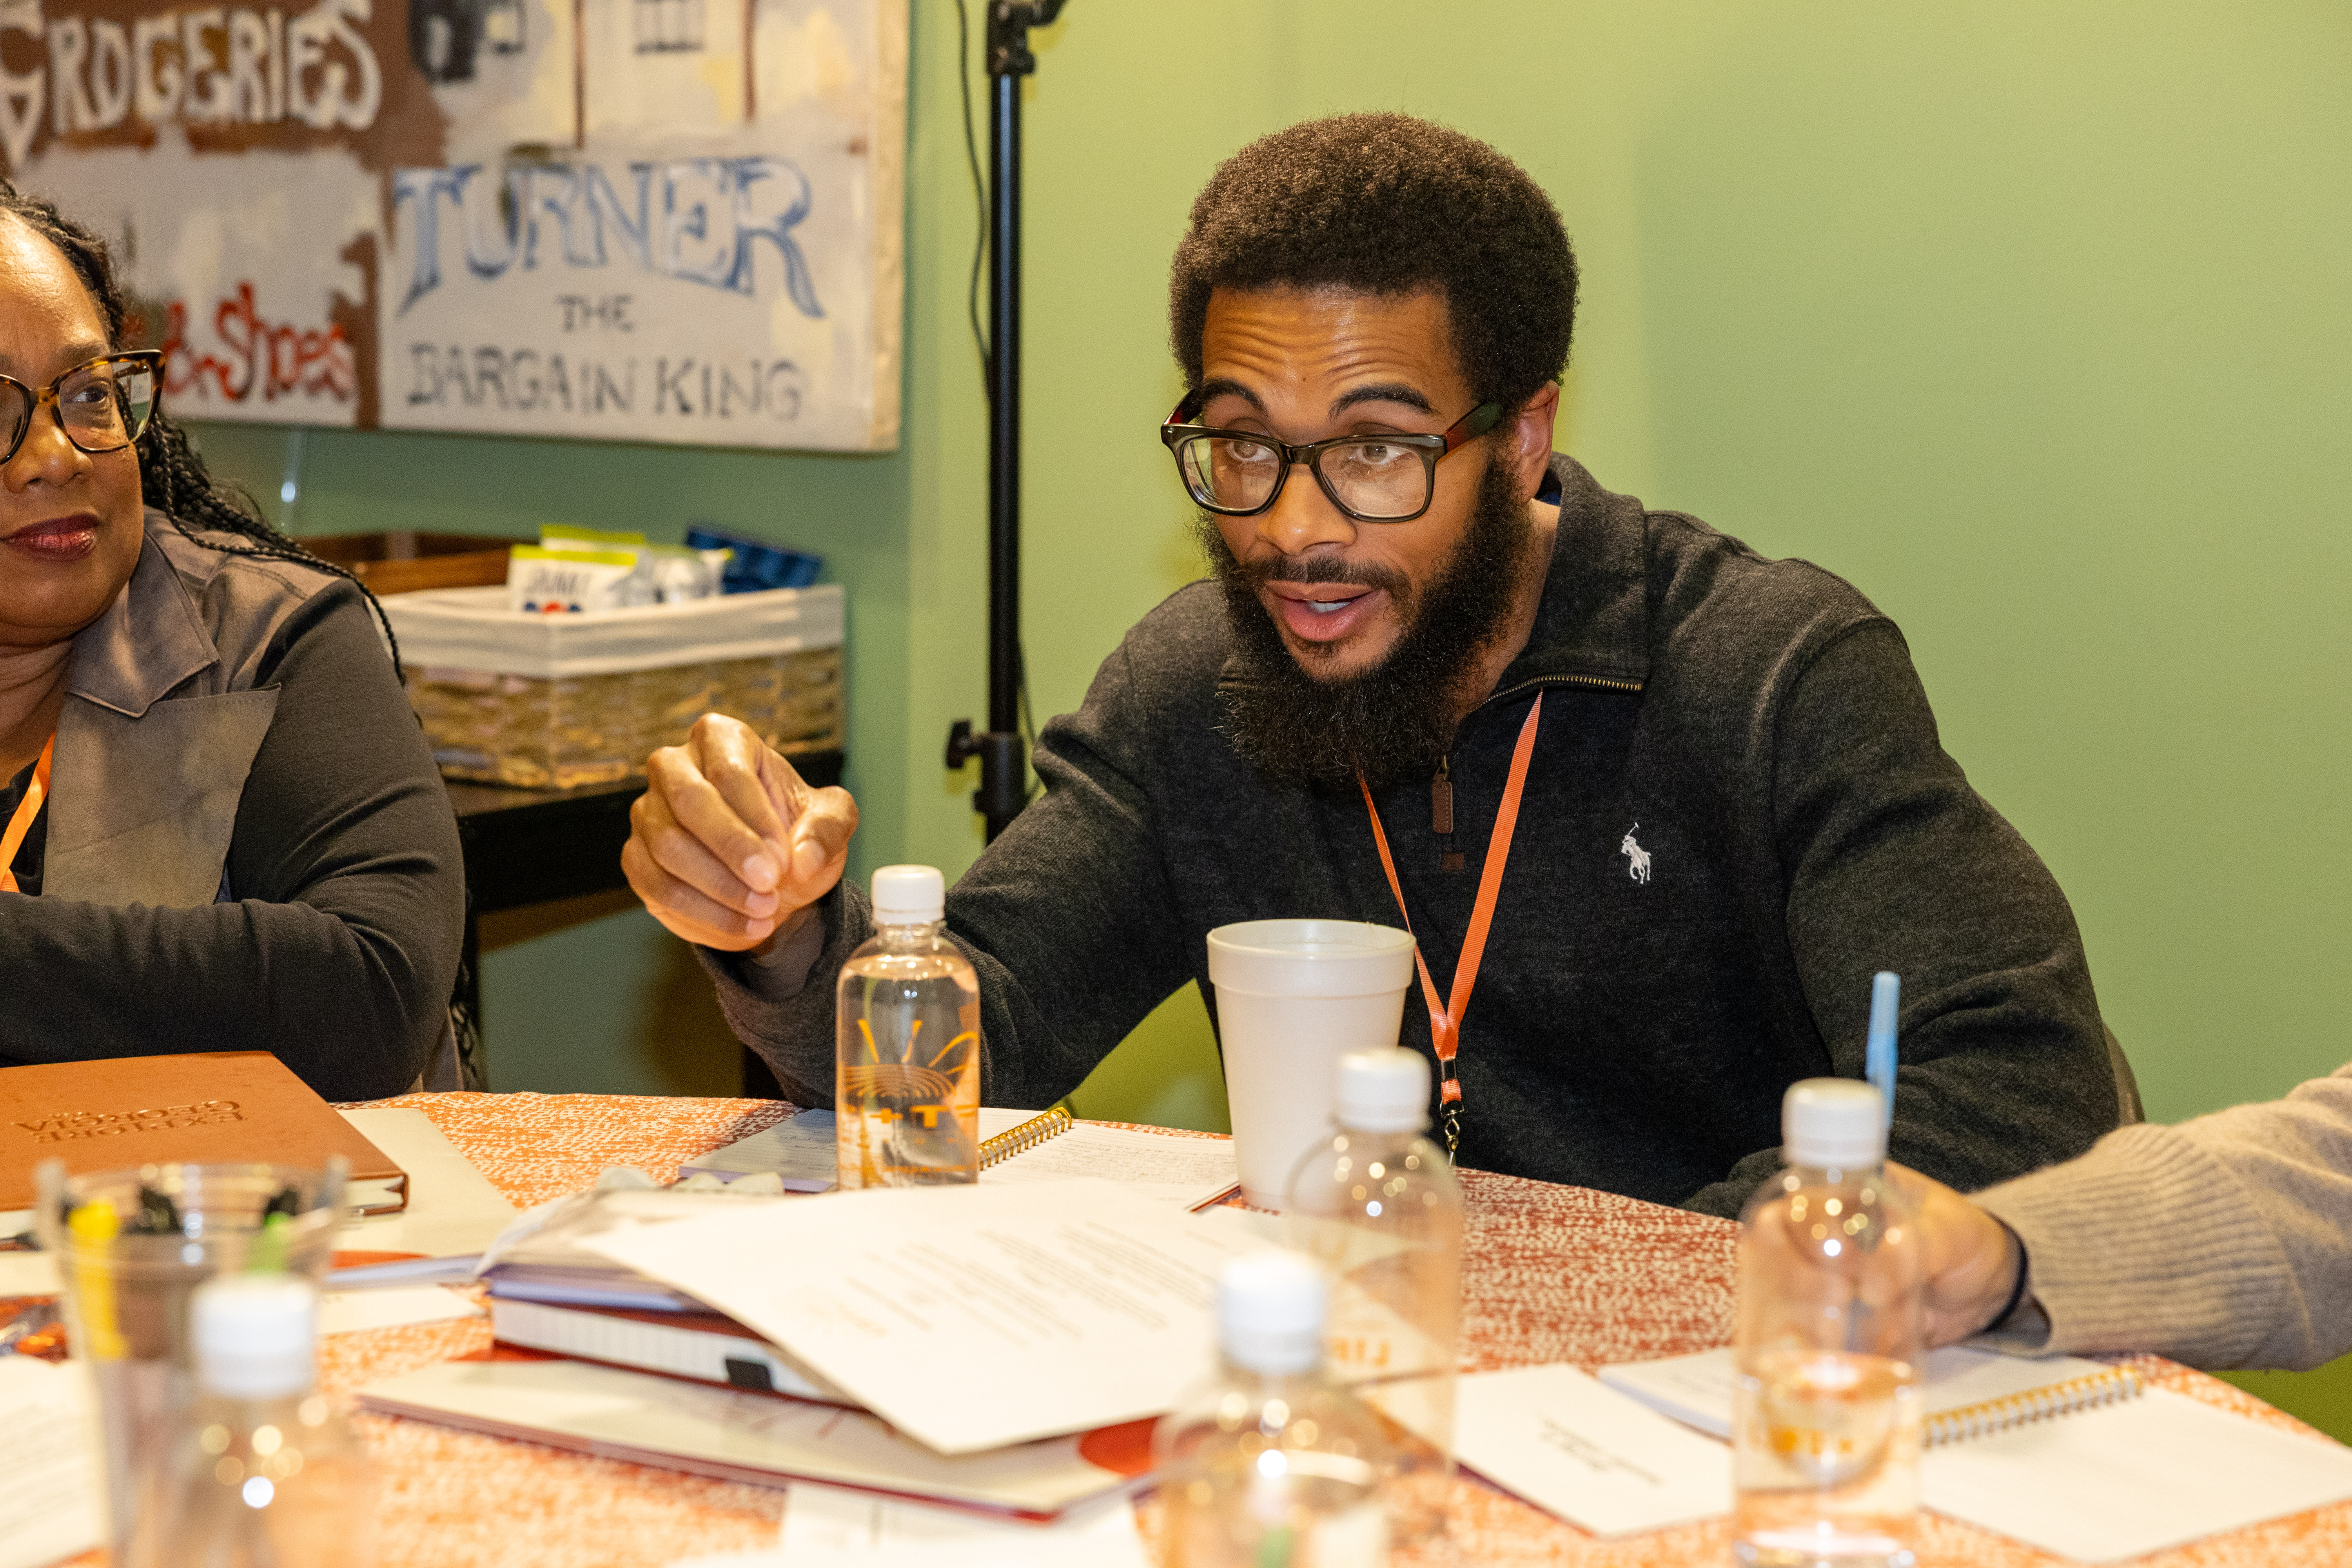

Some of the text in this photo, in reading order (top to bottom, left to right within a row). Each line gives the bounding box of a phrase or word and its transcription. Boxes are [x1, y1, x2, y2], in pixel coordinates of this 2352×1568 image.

[391, 154, 826, 319] TURNER
[554, 294, 634, 333] THE
[406, 342, 804, 421] BARGAIN KING
[11, 1100, 241, 1132] GEORGIA
